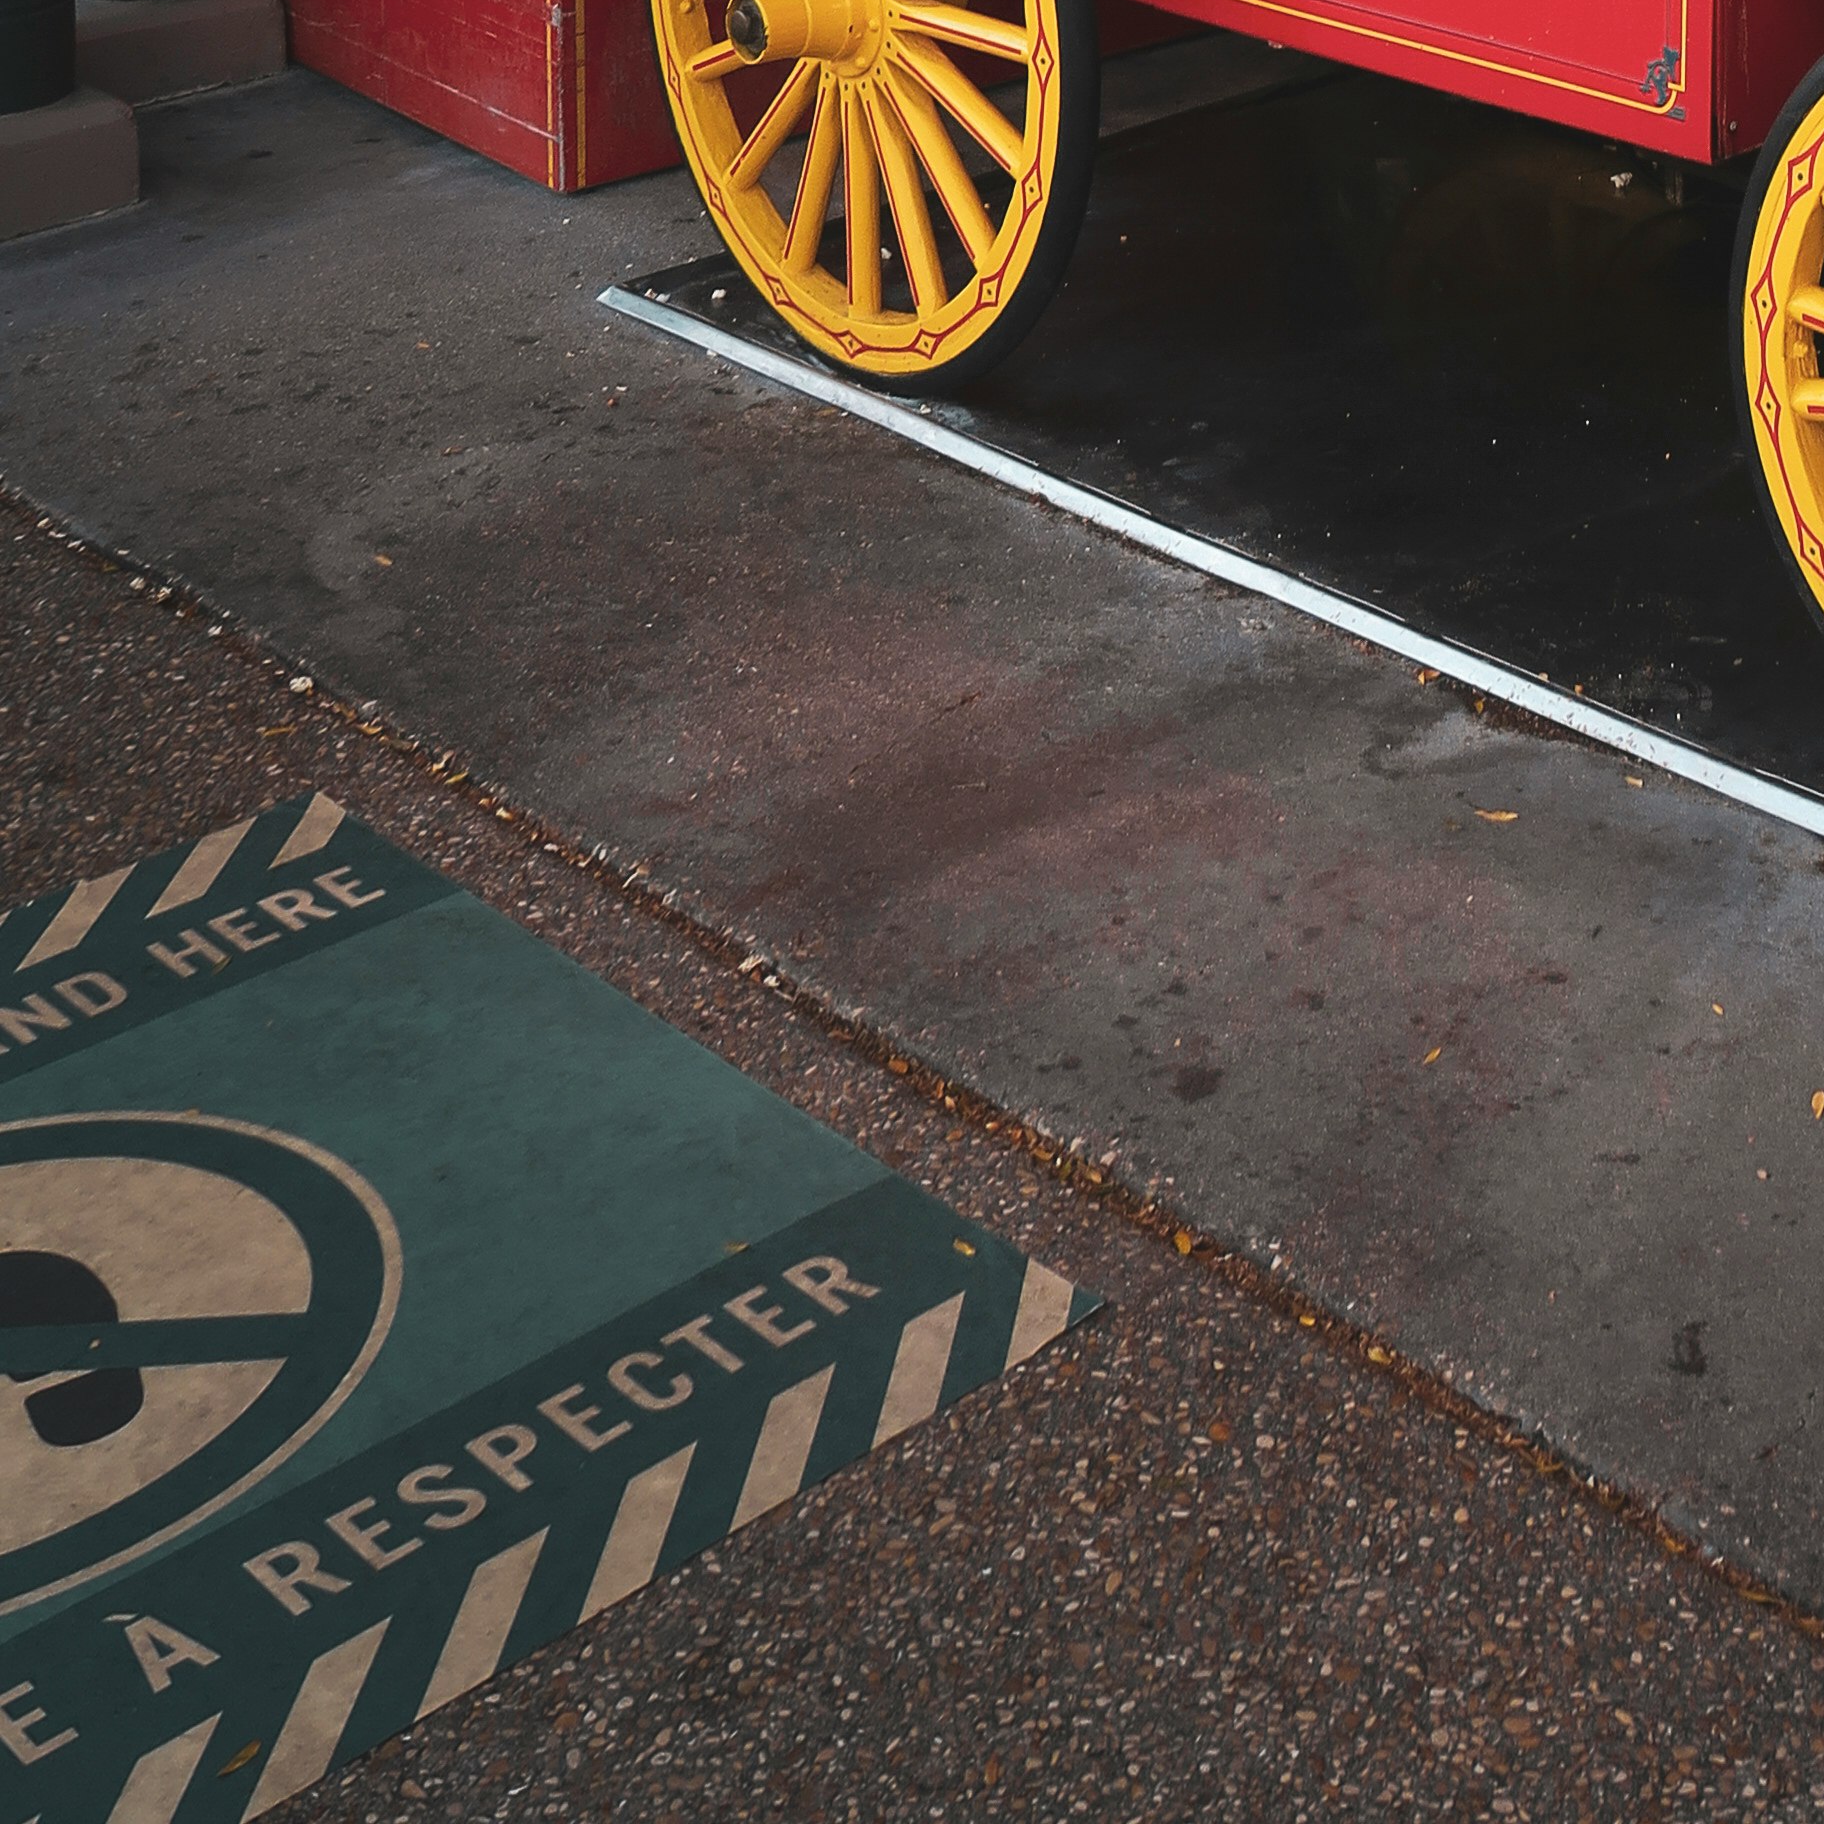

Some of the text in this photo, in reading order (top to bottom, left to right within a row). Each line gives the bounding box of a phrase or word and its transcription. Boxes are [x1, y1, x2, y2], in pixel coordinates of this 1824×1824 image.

[0, 864, 387, 1055] ND HERE
[242, 1253, 882, 1619] RESPECTER
